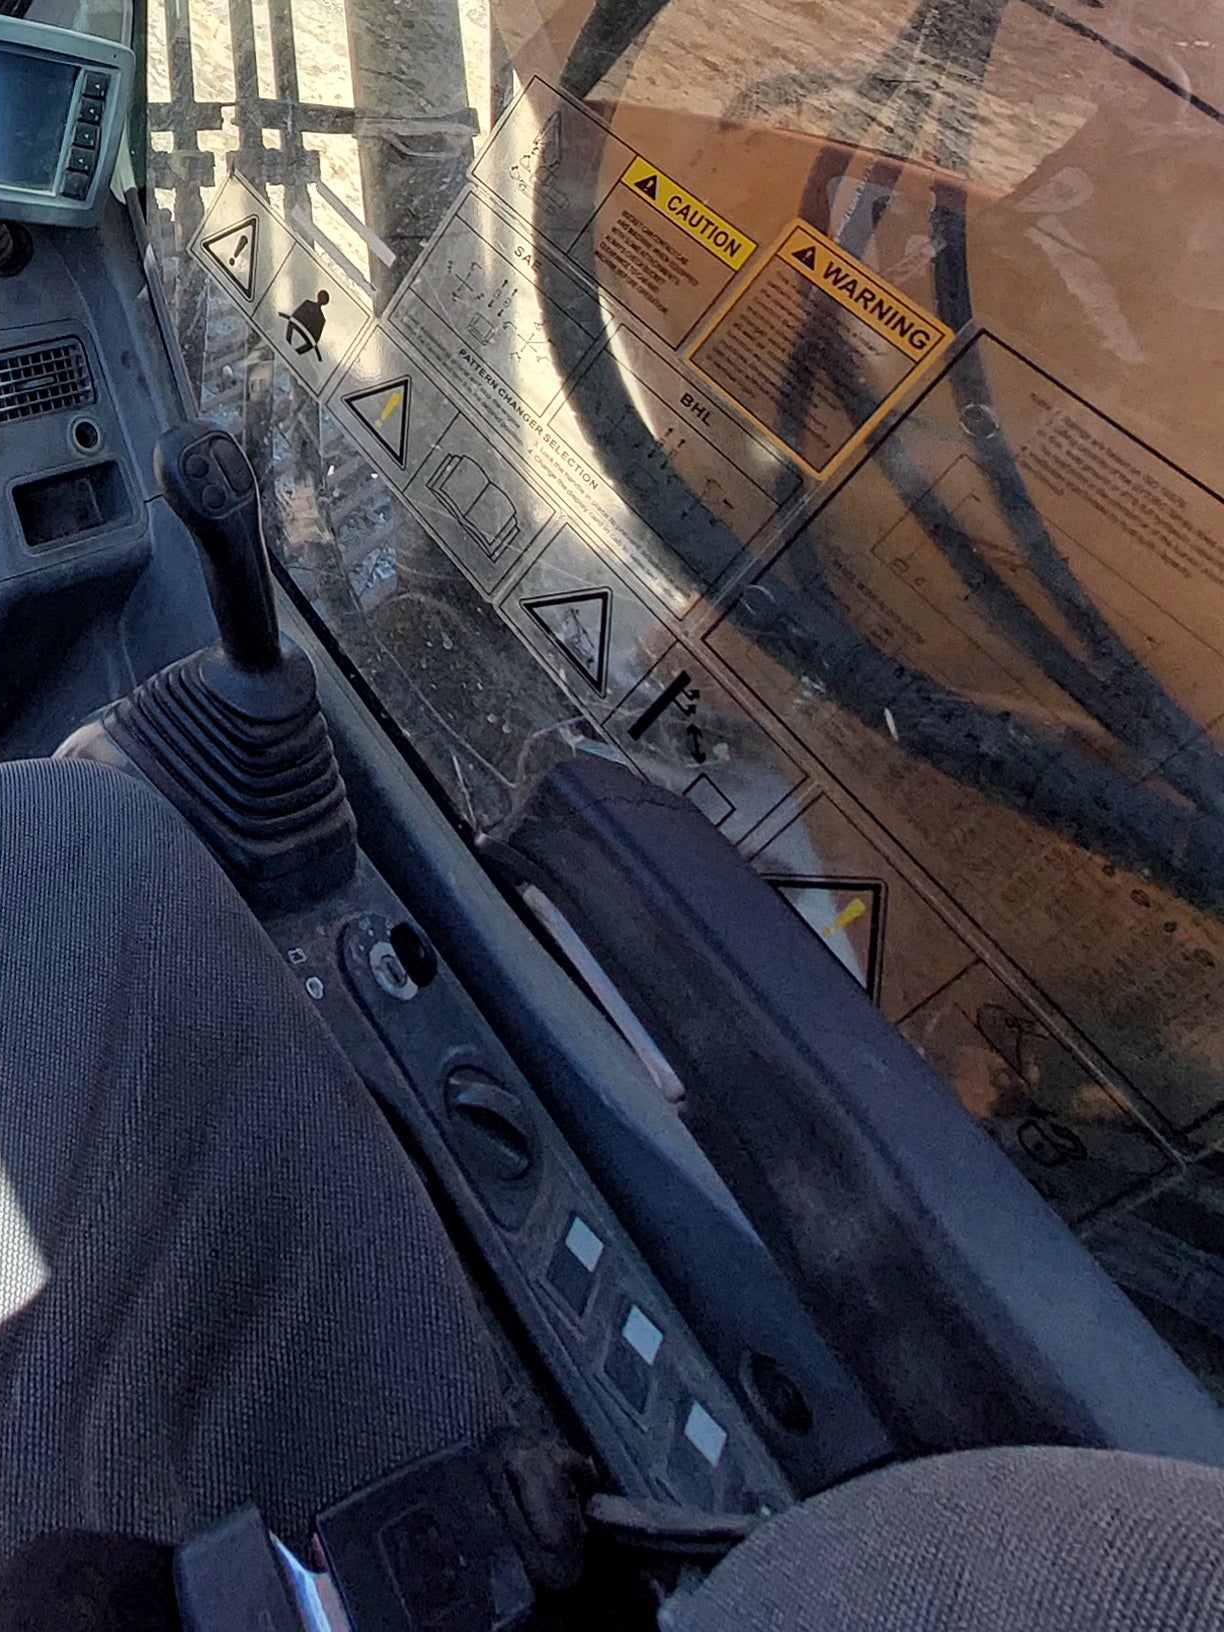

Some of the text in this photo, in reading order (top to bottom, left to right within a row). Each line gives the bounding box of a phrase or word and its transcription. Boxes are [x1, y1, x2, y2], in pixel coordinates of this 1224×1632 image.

[666, 194, 742, 257] CAUTION
[513, 245, 543, 271] SAE
[822, 260, 932, 351] WARNING
[457, 347, 599, 491] PATTERN CHANGER SELECTION
[679, 392, 713, 426] BHL
